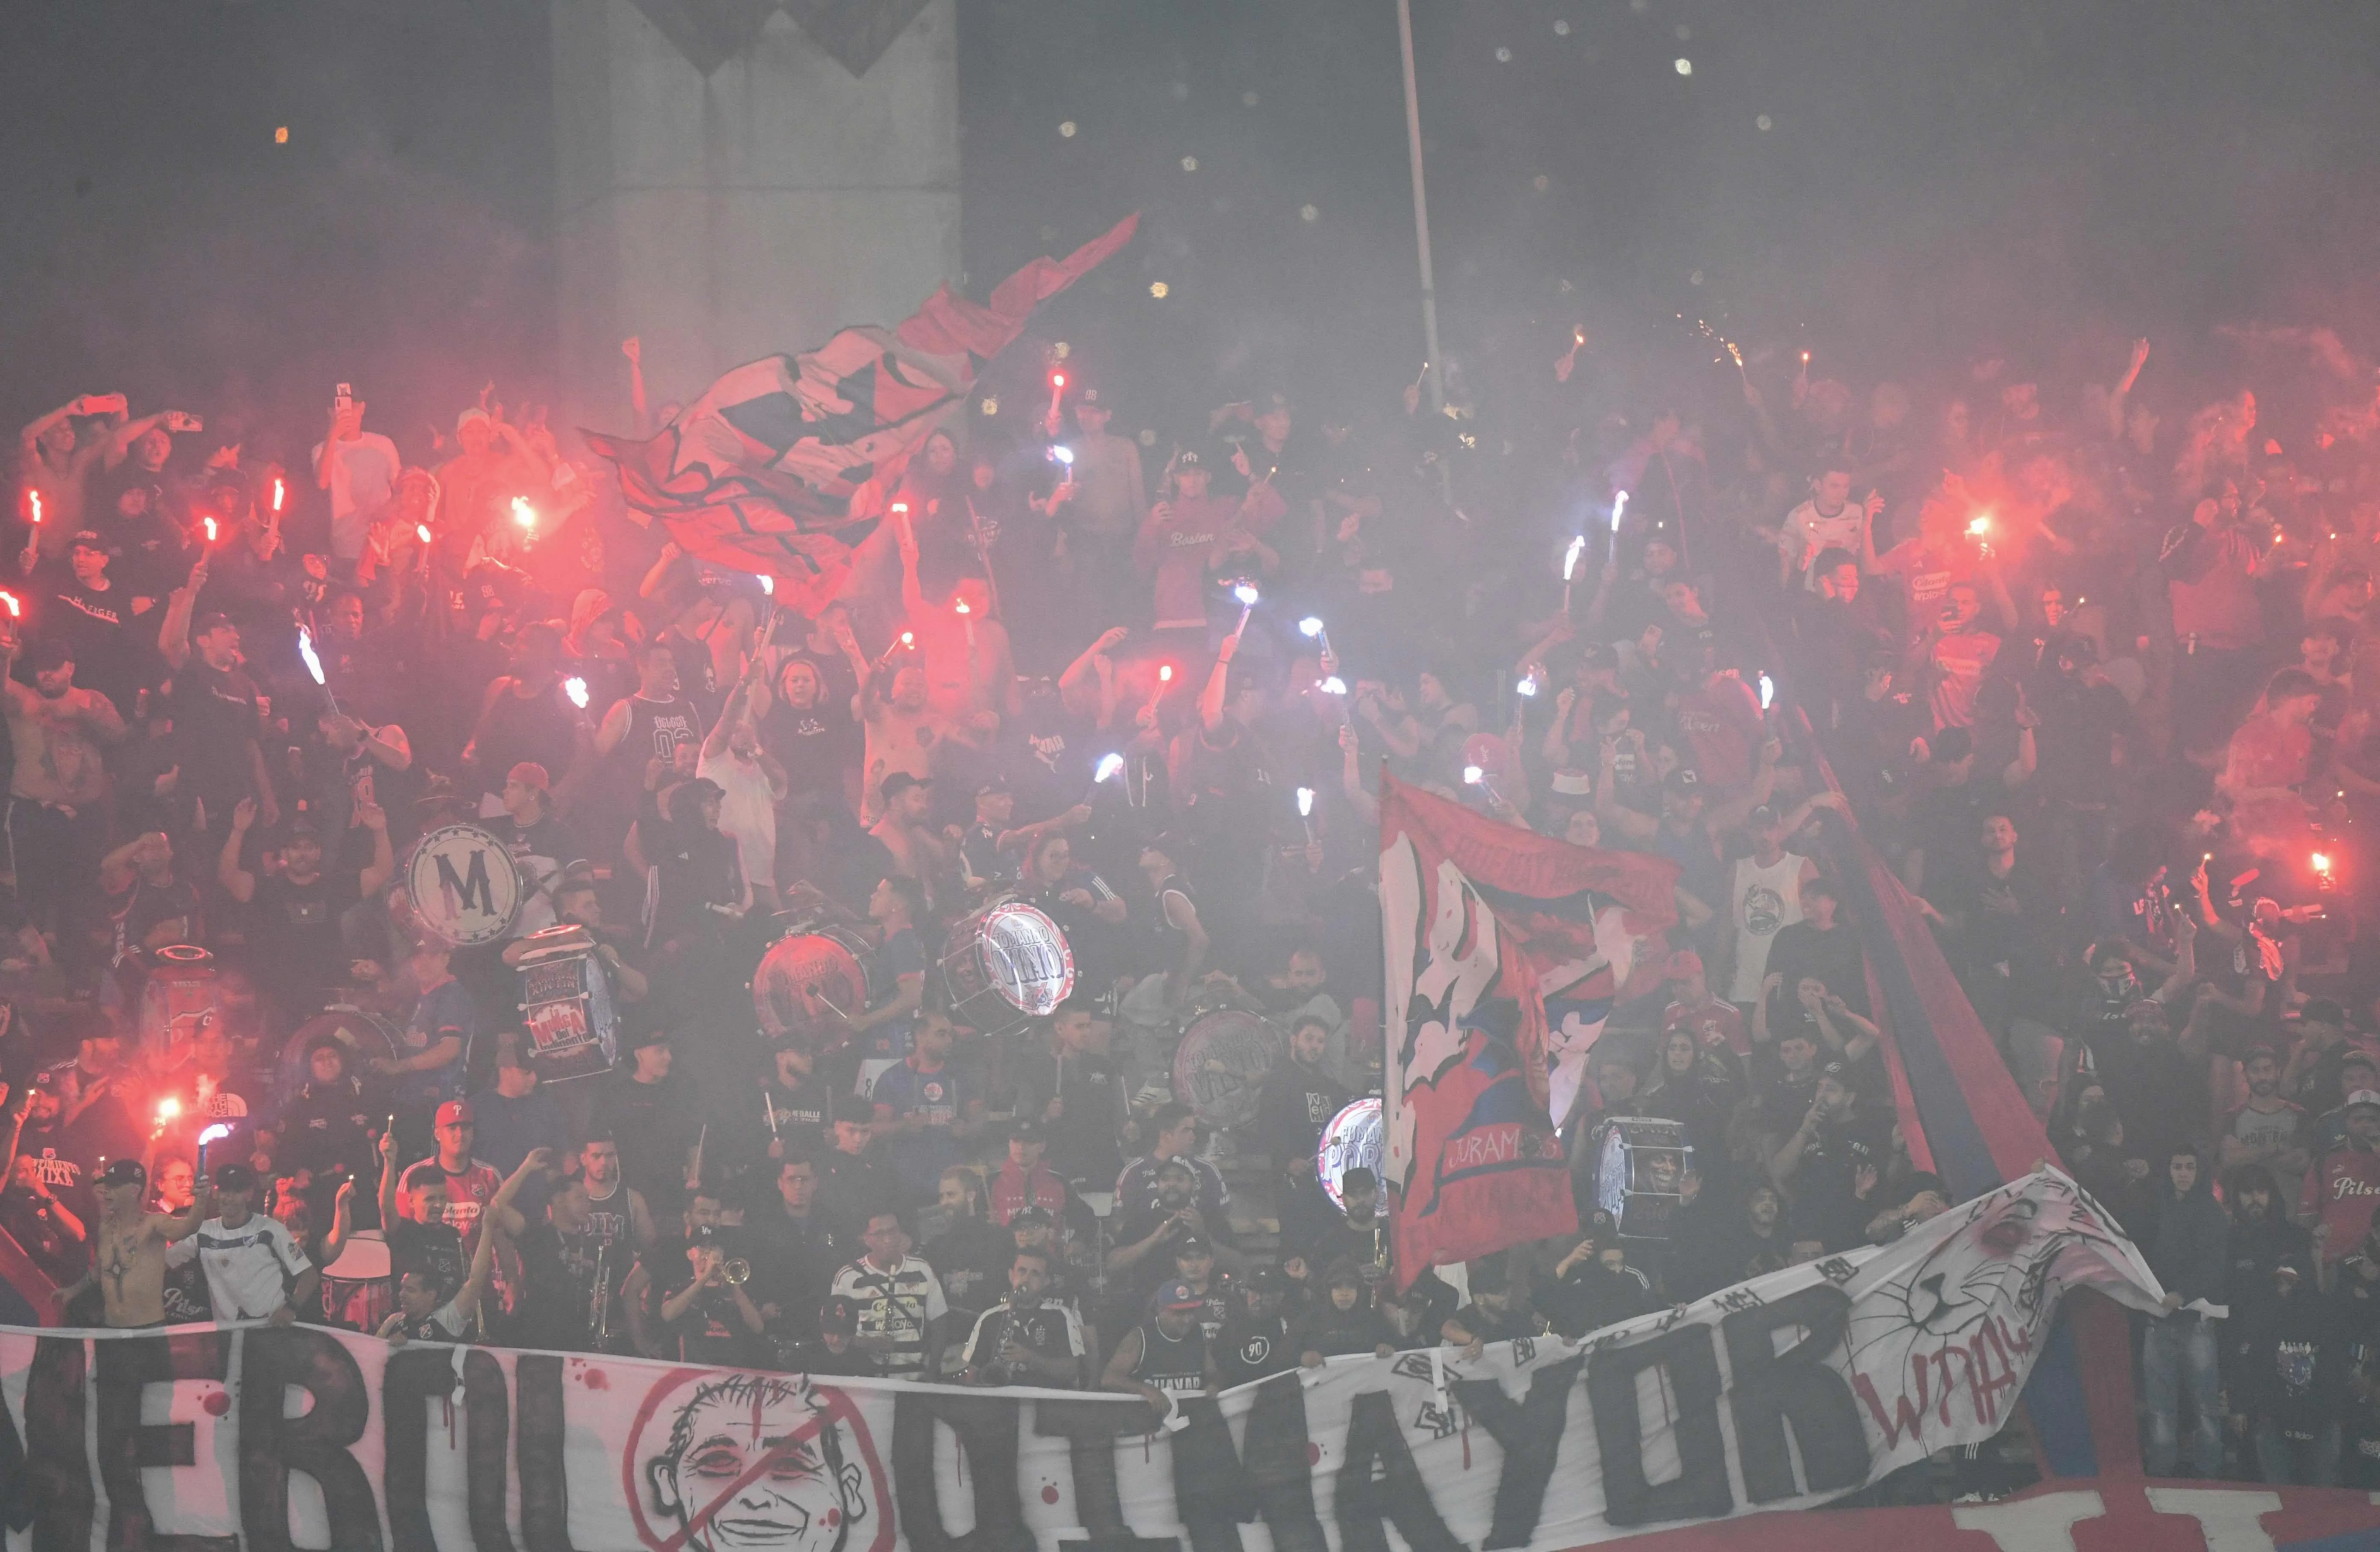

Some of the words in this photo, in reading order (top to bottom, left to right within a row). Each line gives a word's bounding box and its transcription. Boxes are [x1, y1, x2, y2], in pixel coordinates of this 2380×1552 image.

[1170, 532, 1215, 547] Boston
[433, 850, 498, 921] M
[992, 926, 1049, 948] TOMANDO
[992, 944, 1065, 985] VINO
[453, 1105, 462, 1116] P
[1342, 1125, 1384, 1145] FUMAN
[444, 1206, 479, 1216] olanta
[1248, 1341, 1262, 1357] 90
